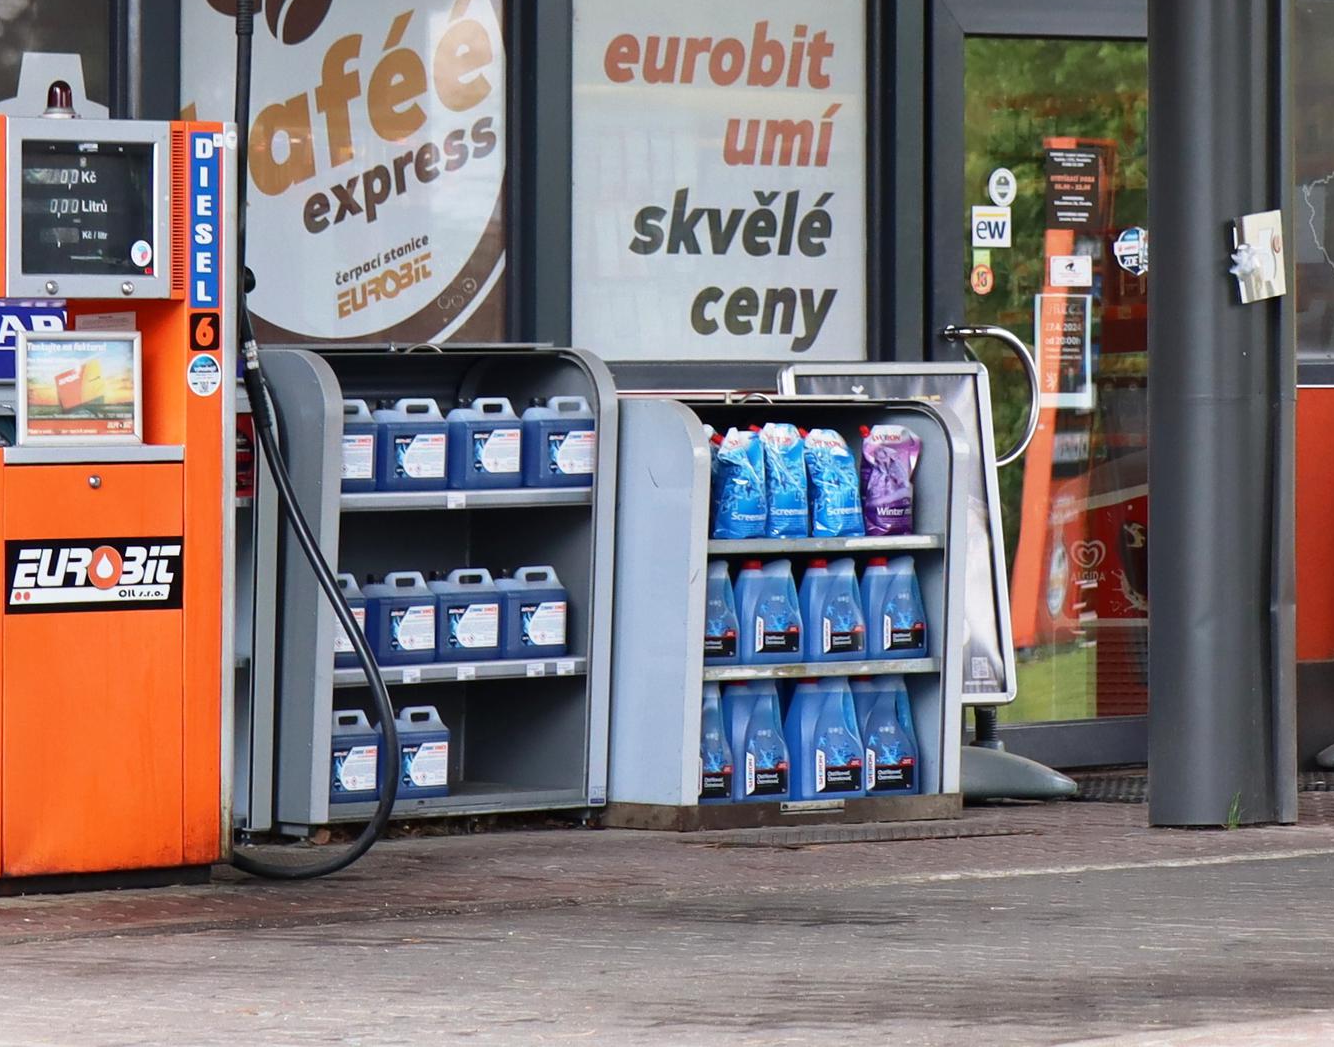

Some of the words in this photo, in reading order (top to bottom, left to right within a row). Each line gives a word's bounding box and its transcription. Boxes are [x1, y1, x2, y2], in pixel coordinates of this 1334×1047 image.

[603, 20, 835, 90] eurobit
[723, 102, 843, 167] umí
[81, 170, 97, 184] Kč
[302, 116, 497, 234] express
[81, 199, 108, 213] Litrů
[194, 136, 214, 303] DIESEL
[628, 187, 835, 257] skvělé
[976, 220, 1006, 239] ew
[335, 255, 382, 286] čerpací
[384, 234, 430, 265] stanice
[195, 317, 215, 346] 6
[690, 286, 839, 353] ceny
[876, 505, 903, 516] Winter
